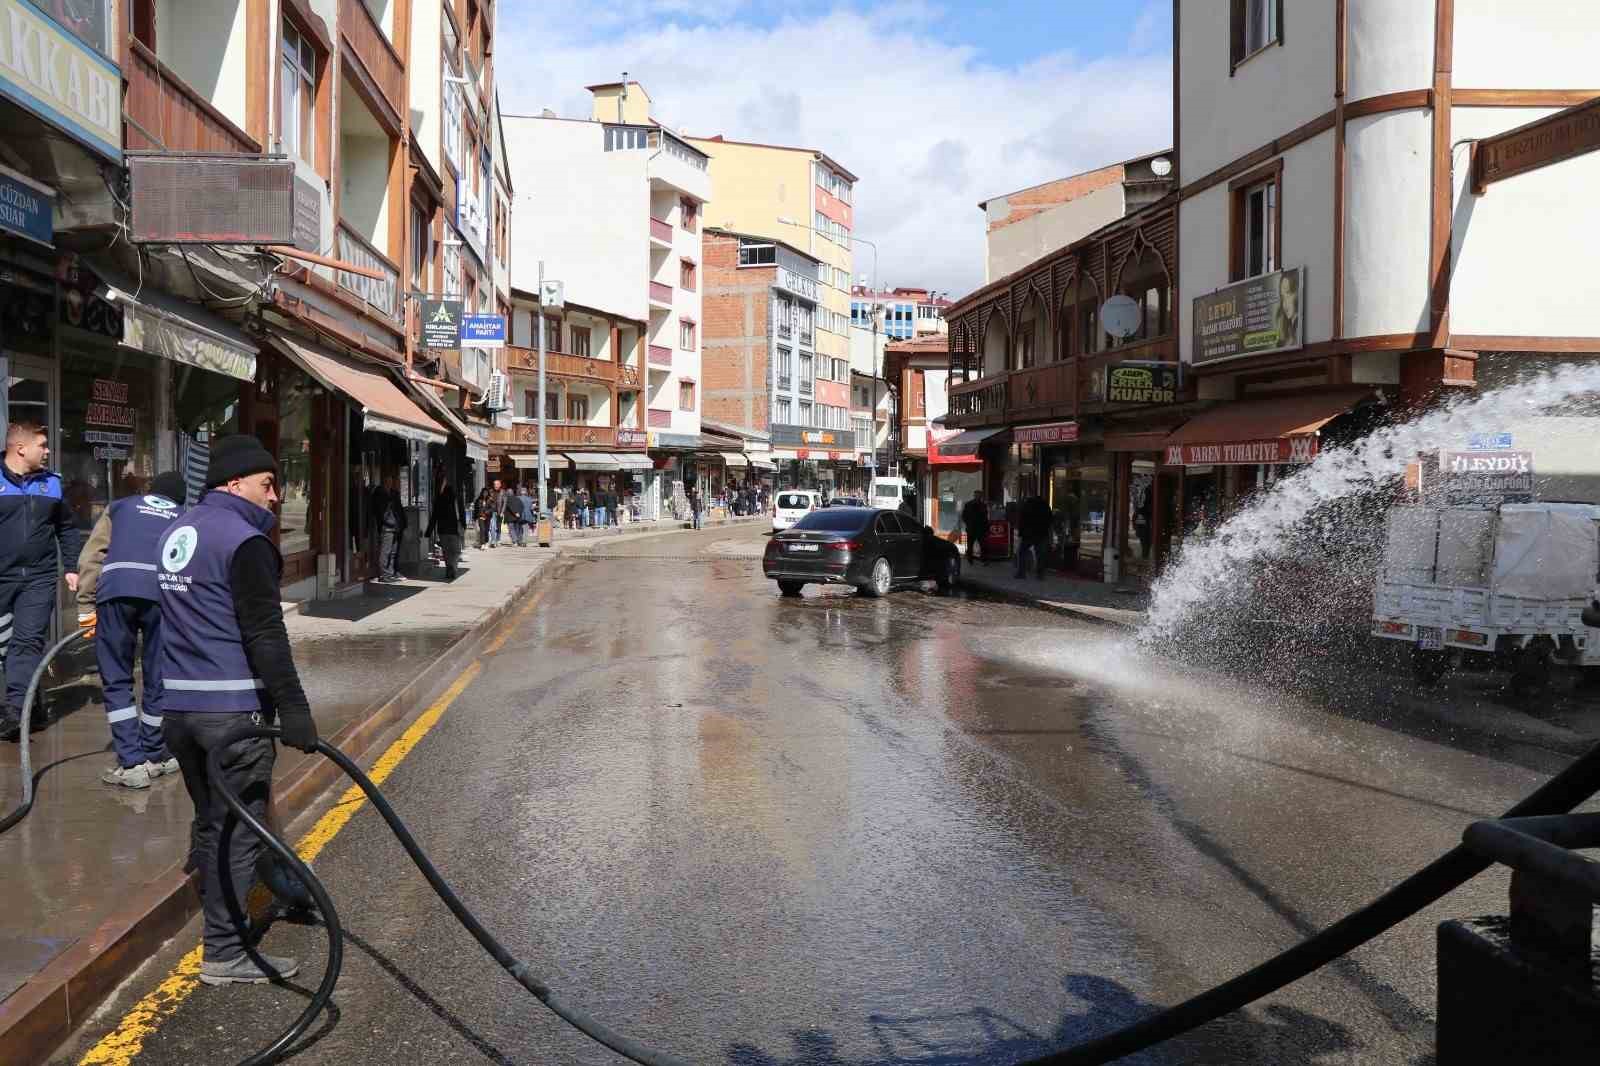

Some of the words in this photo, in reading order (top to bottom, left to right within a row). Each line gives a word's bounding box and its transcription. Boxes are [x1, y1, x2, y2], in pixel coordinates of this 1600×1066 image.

[1110, 376, 1152, 388] ERKEK
[1110, 386, 1174, 403] KUAFÖR
[1191, 445, 1221, 462] YAREN
[1223, 440, 1279, 462] TUHAFİYE
